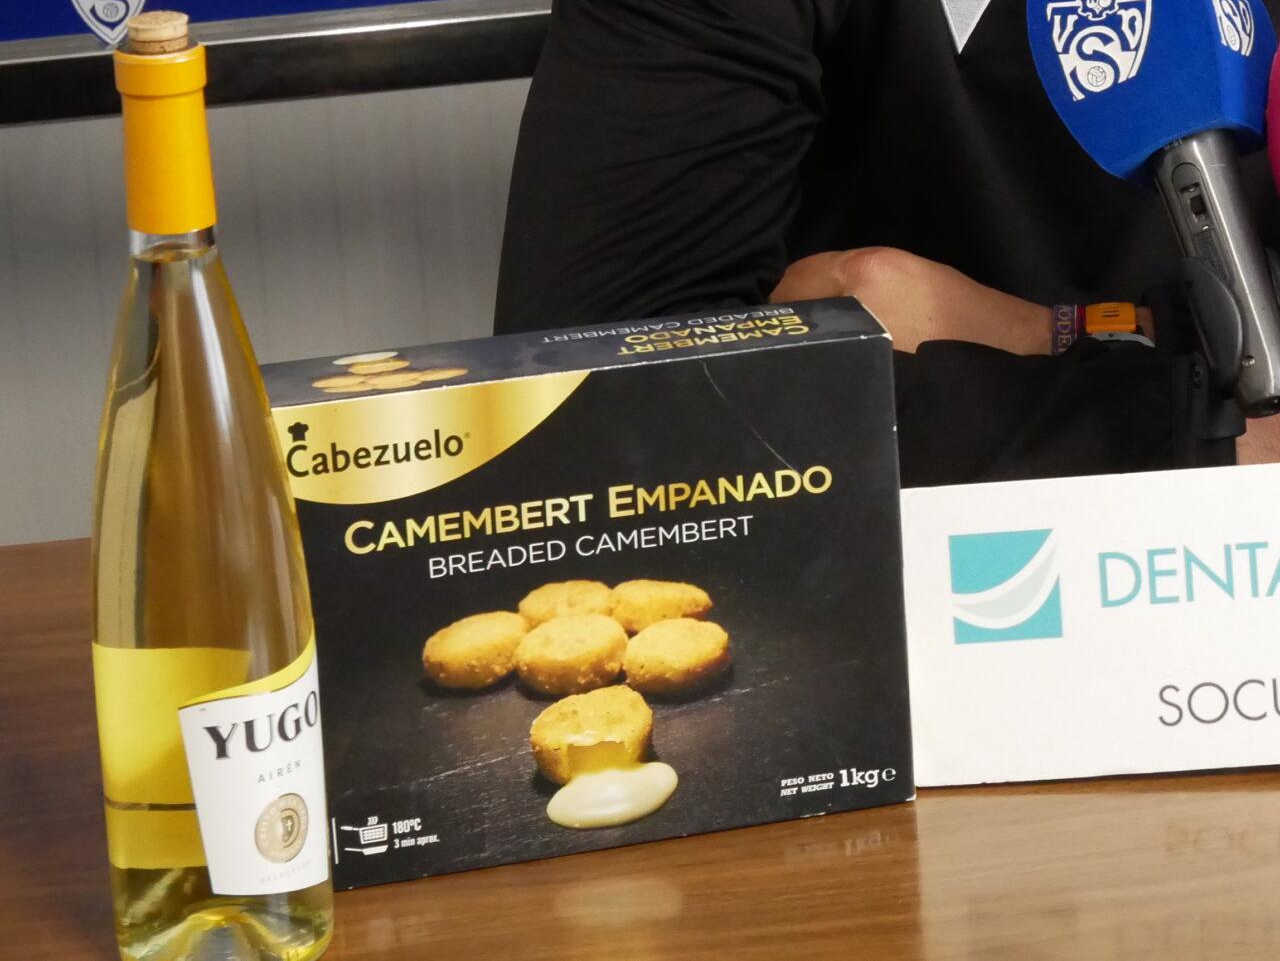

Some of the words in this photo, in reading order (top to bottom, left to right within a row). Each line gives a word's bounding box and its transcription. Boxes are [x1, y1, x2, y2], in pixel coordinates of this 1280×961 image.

[687, 307, 795, 326] BREADED
[543, 321, 682, 344] CAMEMBERT
[616, 324, 810, 356] CAMEMBERT
[624, 315, 803, 343] EMPANADO
[286, 429, 465, 479] Cabezuelo
[344, 494, 594, 555] CAMEMBERT
[608, 465, 833, 519] EMPANADO
[428, 539, 567, 579] BREADED
[575, 515, 754, 557] CAMEMBERT
[203, 690, 318, 761] YUGO
[257, 760, 302, 784] AIRÉN
[780, 776, 805, 787] PESO
[808, 772, 835, 783] NETO
[839, 768, 880, 788] 1kg
[780, 787, 798, 797] NET
[801, 781, 835, 794] WEIGHT
[393, 838, 400, 849] 3
[401, 836, 416, 848] min
